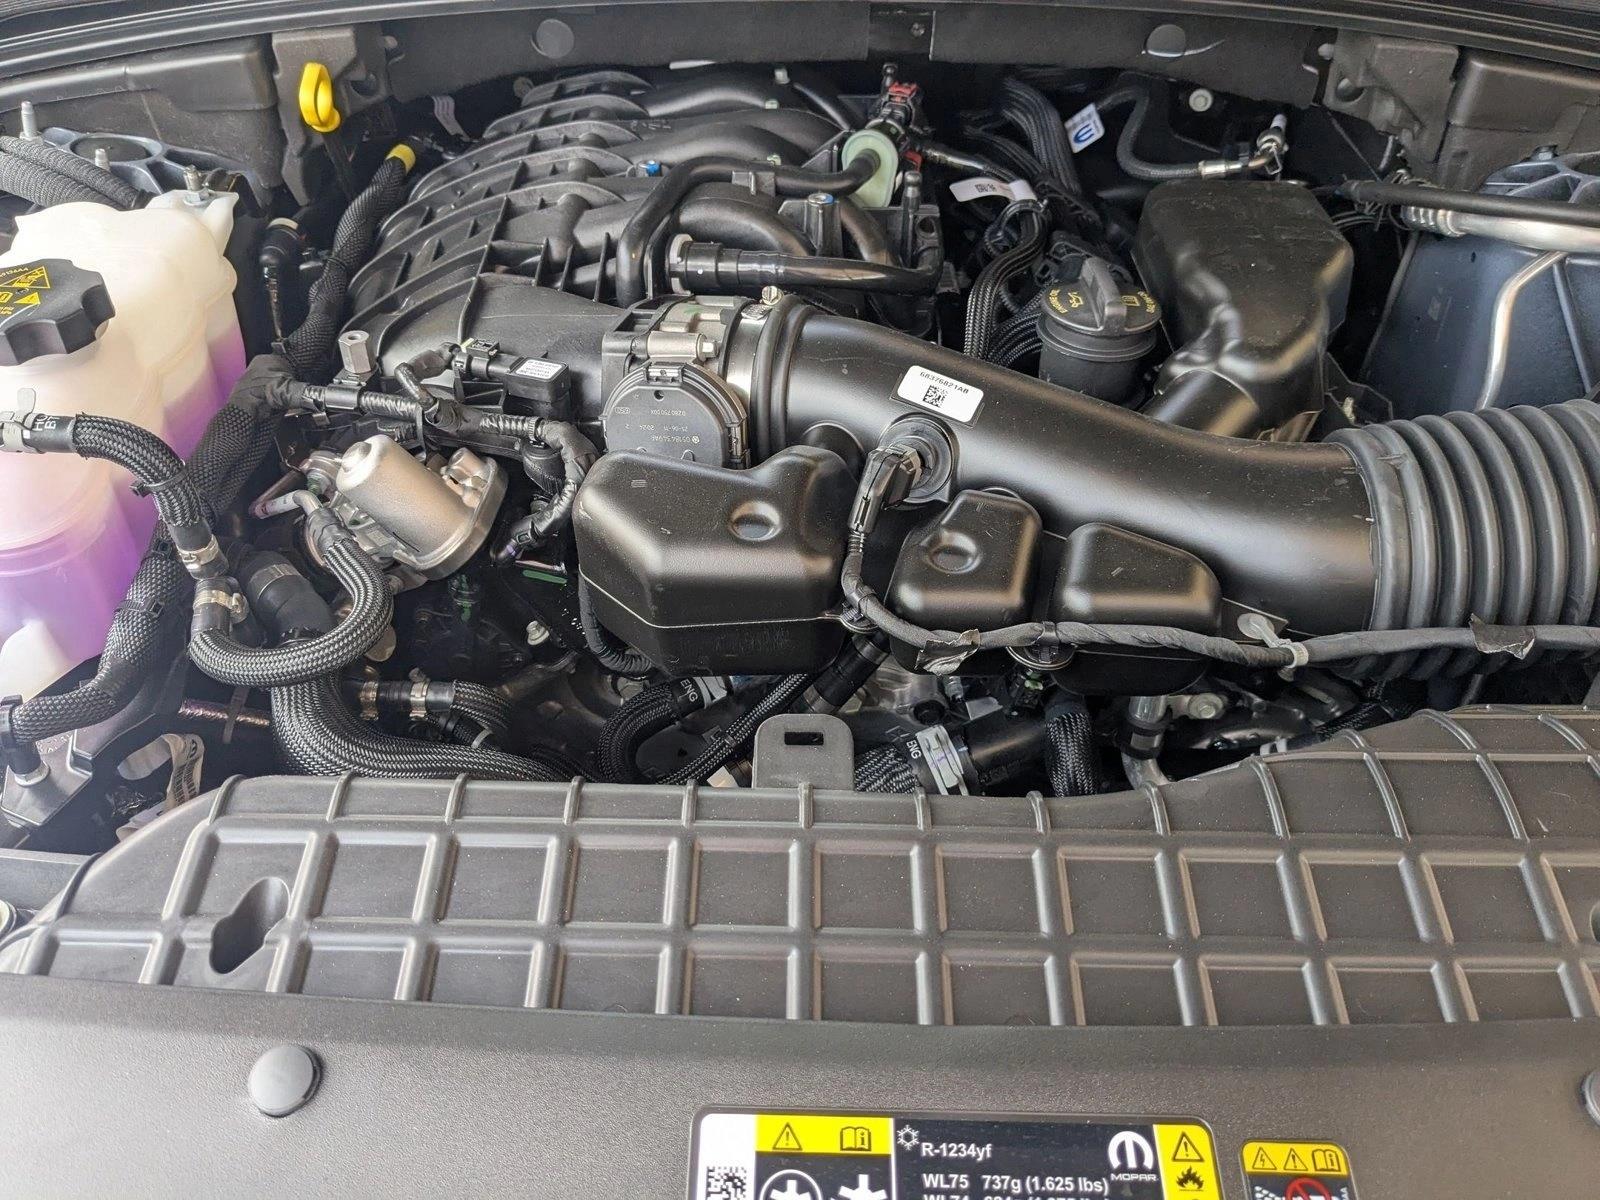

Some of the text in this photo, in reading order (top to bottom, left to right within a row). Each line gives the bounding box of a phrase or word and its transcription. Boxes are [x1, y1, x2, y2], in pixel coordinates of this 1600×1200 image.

[919, 371, 969, 394] 68376821AB
[680, 678, 698, 702] ENG
[905, 739, 922, 760] ENG
[920, 1142, 992, 1163] R-1234yf
[922, 1173, 1110, 1197] WL75 737g (1.625 lbs)
[1110, 1172, 1157, 1182] MOPAR
